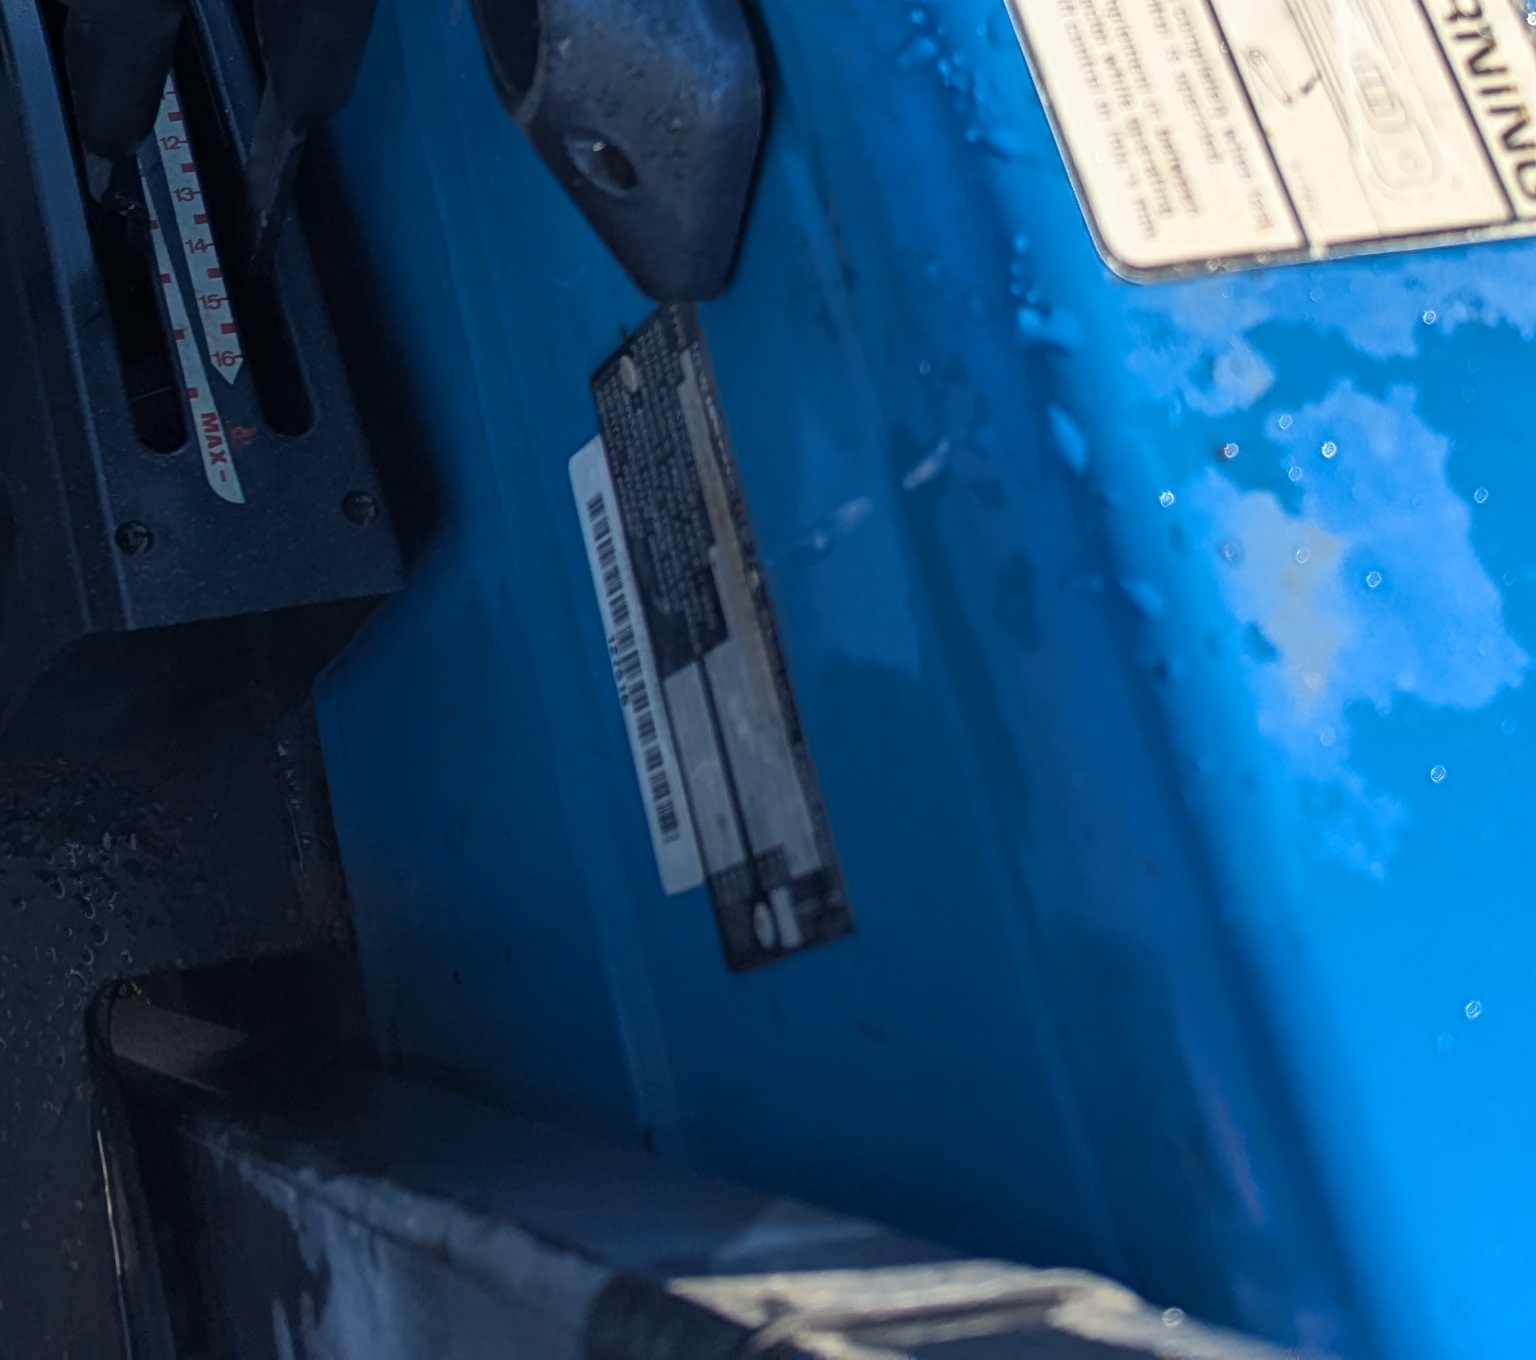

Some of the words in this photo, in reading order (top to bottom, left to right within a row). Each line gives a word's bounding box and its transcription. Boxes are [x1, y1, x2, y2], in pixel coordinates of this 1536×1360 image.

[159, 134, 181, 151] 12
[172, 186, 195, 203] 13
[184, 237, 207, 255] 14
[199, 294, 222, 311] 15
[212, 350, 236, 368] 16
[200, 412, 227, 464] MAX
